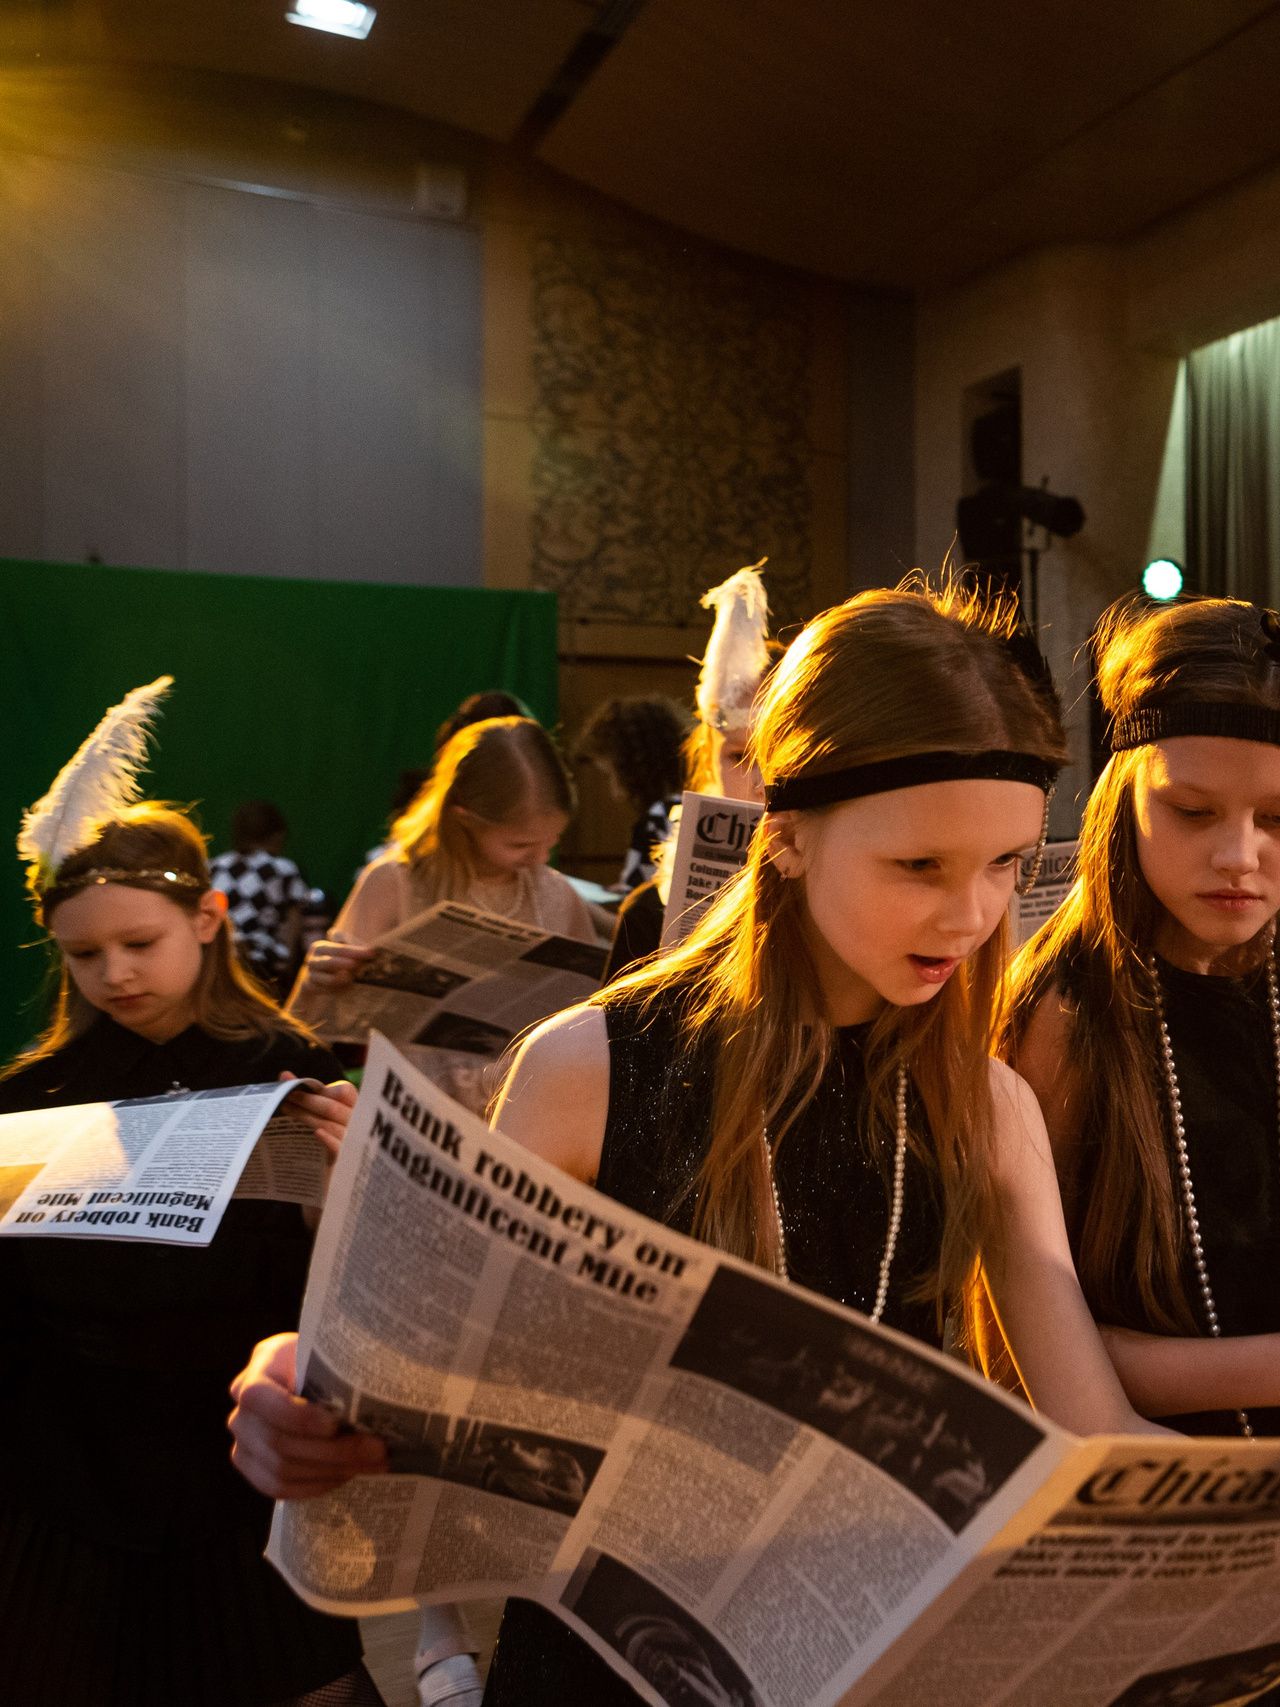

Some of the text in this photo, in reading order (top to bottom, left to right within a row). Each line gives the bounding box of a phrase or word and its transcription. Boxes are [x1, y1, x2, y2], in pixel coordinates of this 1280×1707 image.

[15, 1209, 205, 1233] Bank robbery on
[37, 1191, 215, 1212] Magnificent Mile
[370, 1111, 568, 1269] Magnificent
[577, 1253, 659, 1305] Mile
[380, 1066, 462, 1161] Bank
[473, 1143, 633, 1253] robbery
[636, 1238, 692, 1279] on
